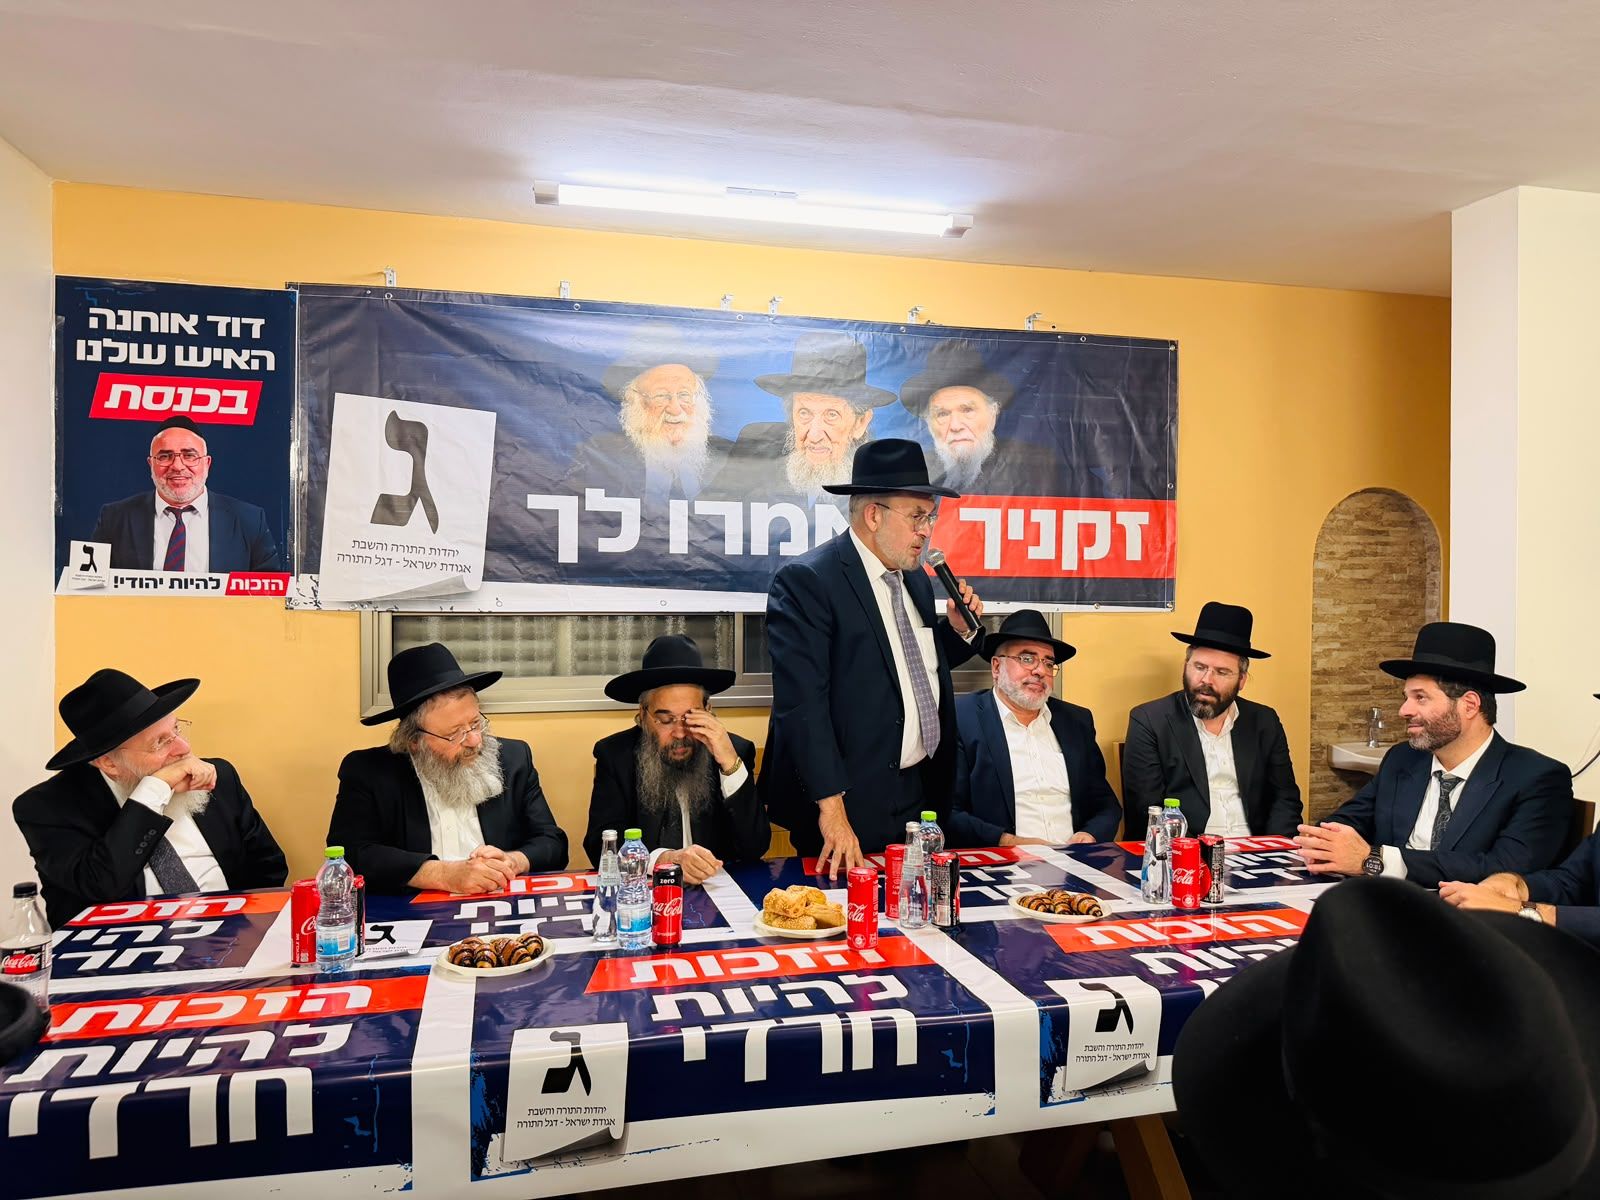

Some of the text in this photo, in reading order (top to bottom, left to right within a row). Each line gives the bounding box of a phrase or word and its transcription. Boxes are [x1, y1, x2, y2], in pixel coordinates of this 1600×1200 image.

[88, 307, 266, 339] דוד אוחנה
[76, 337, 276, 371] האיש שלנו
[103, 383, 249, 415] בכנסת
[369, 409, 440, 535] ג
[526, 487, 641, 563] לך
[351, 539, 460, 558] יהדות התורה והשבת
[959, 507, 1150, 571] זקניך
[79, 544, 98, 573] ג
[336, 552, 372, 565] התורה
[374, 554, 393, 567] דגל
[402, 557, 437, 570] ישראל
[439, 563, 472, 574] אגודת
[113, 575, 285, 592] הזכות להיות יהודי!
[1075, 914, 1302, 946] הזכות
[650, 973, 910, 1022] להיות
[47, 985, 373, 1035] הזכות
[1078, 981, 1134, 1035] ג
[3, 1022, 354, 1085] להיות
[680, 1007, 918, 1083] חרדי
[1083, 1044, 1105, 1052] והשבת
[540, 1030, 592, 1097] ג
[1075, 1055, 1097, 1063] התורה
[1096, 1054, 1108, 1062] דגל
[1112, 1053, 1132, 1061] ישראל
[1132, 1052, 1150, 1060] אגודת
[7, 1066, 314, 1160] חרדי
[527, 1106, 607, 1116] יהדות התורה והשבת
[516, 1120, 543, 1129] התורה
[544, 1118, 558, 1128] דגל
[565, 1117, 591, 1127] ישראל
[592, 1117, 616, 1126] אגודת
